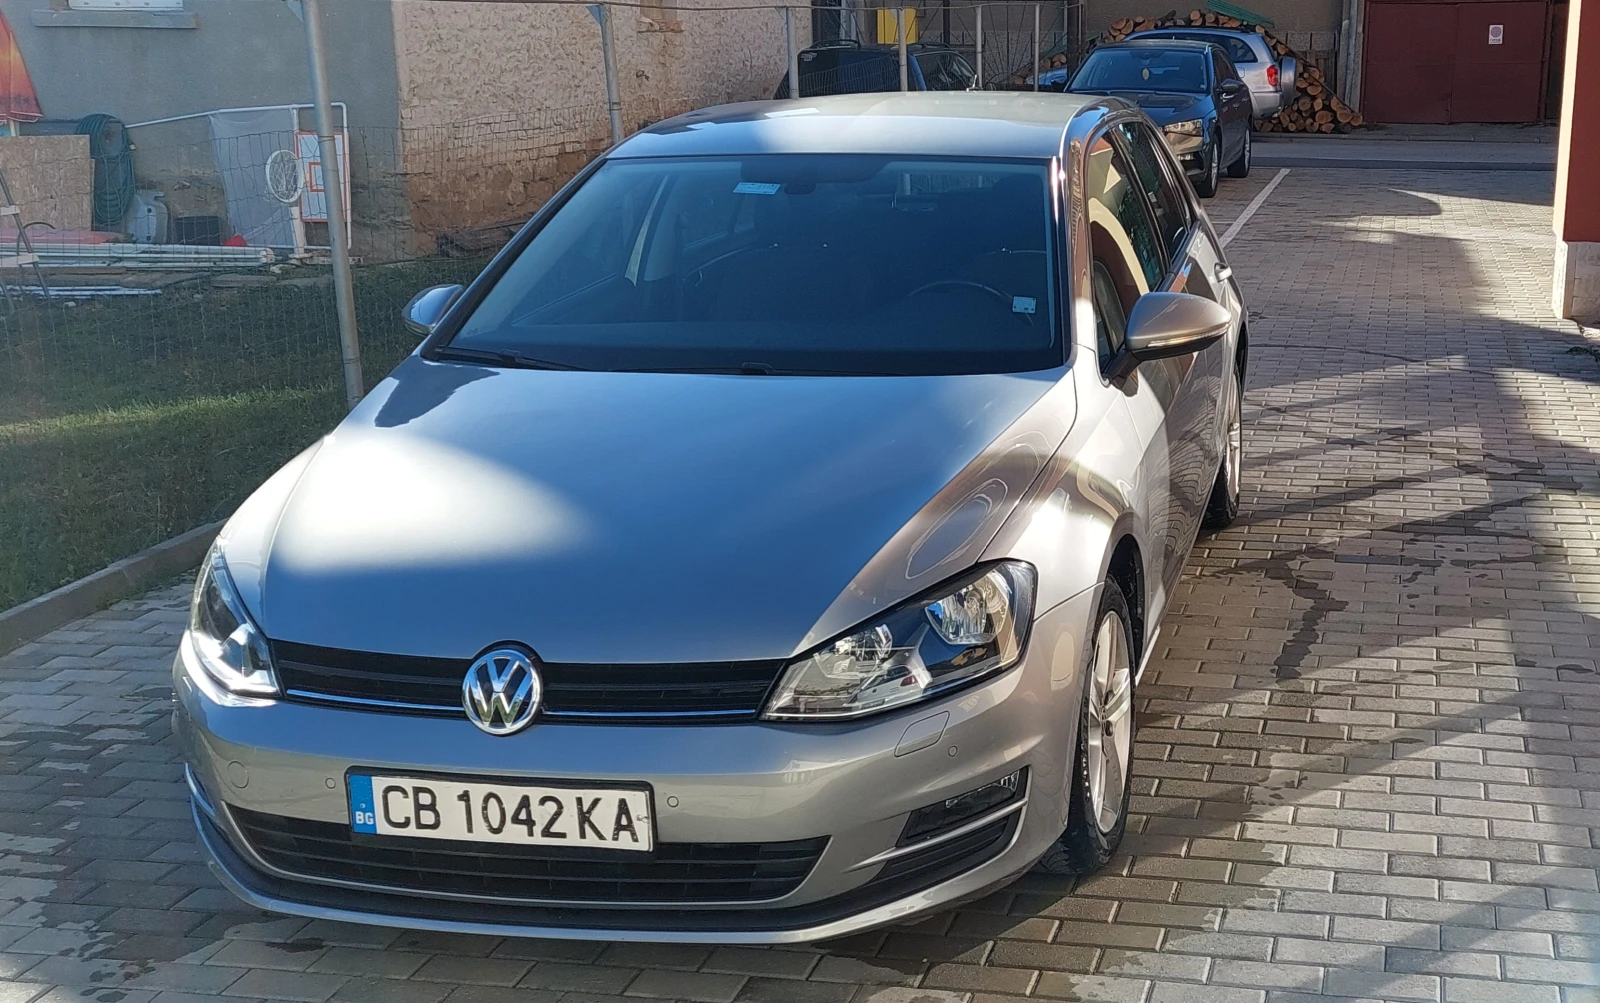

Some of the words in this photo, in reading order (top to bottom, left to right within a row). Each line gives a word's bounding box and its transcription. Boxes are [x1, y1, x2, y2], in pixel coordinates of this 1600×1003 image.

[355, 811, 374, 825] BG
[381, 785, 441, 830] CB
[457, 789, 567, 839] 1042
